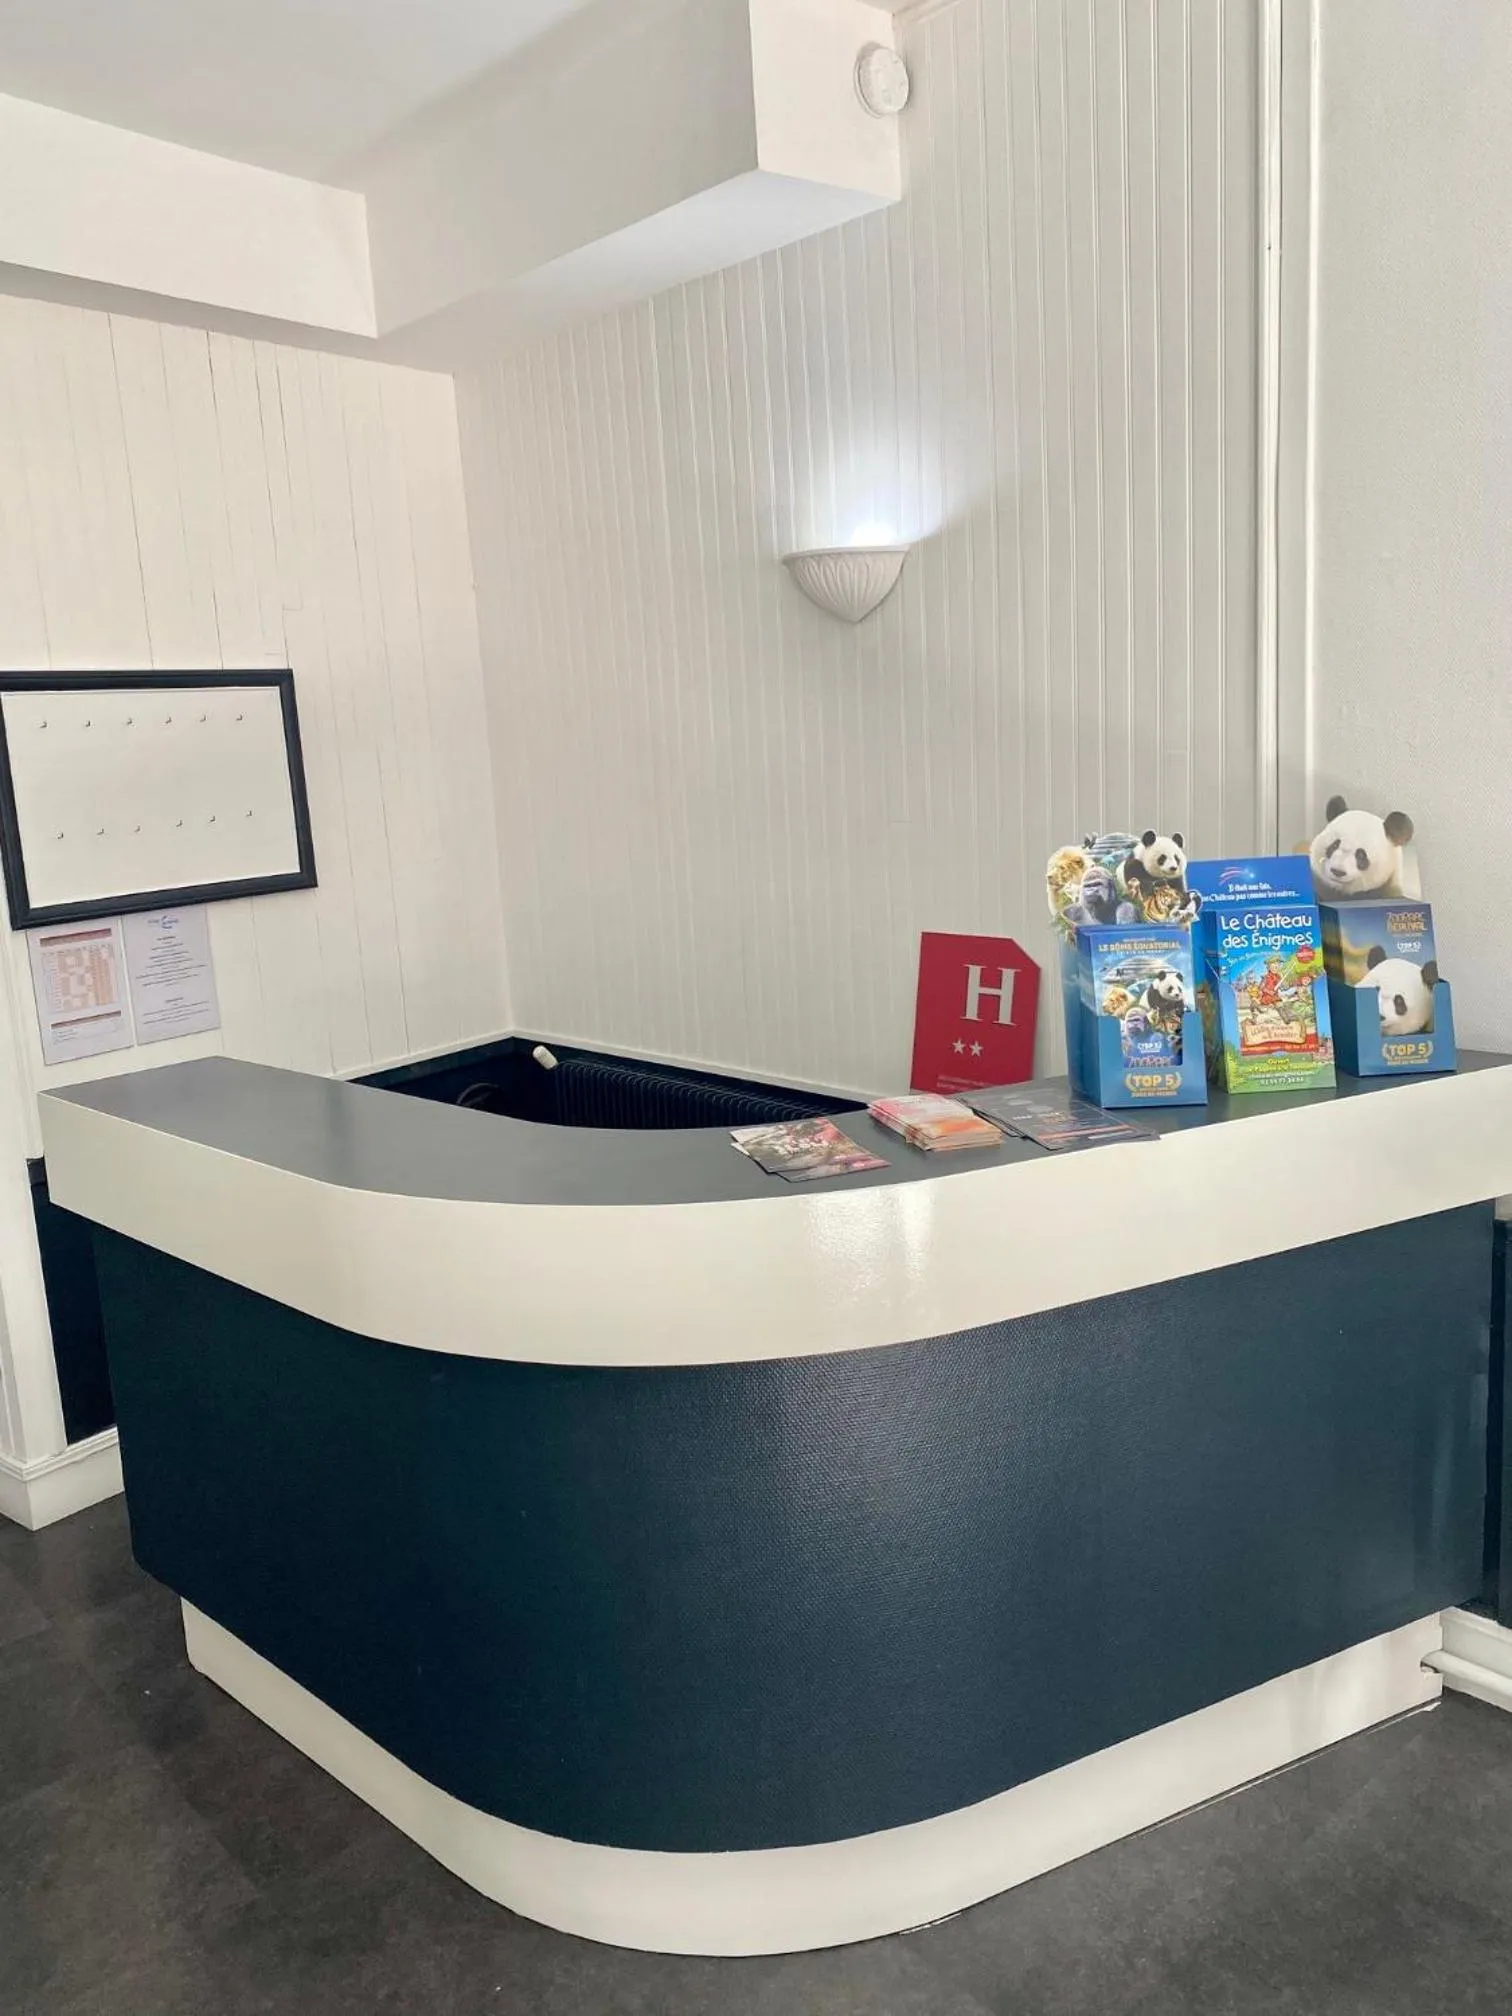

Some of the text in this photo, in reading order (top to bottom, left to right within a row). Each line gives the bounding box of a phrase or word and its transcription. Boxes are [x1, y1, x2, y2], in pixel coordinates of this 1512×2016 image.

[1221, 912, 1312, 930] Le Château
[1222, 930, 1314, 951] des Énigmes
[960, 963, 1022, 1026] H
[1390, 1042, 1427, 1056] TOP 5
[1132, 1073, 1176, 1088] TOP 5
